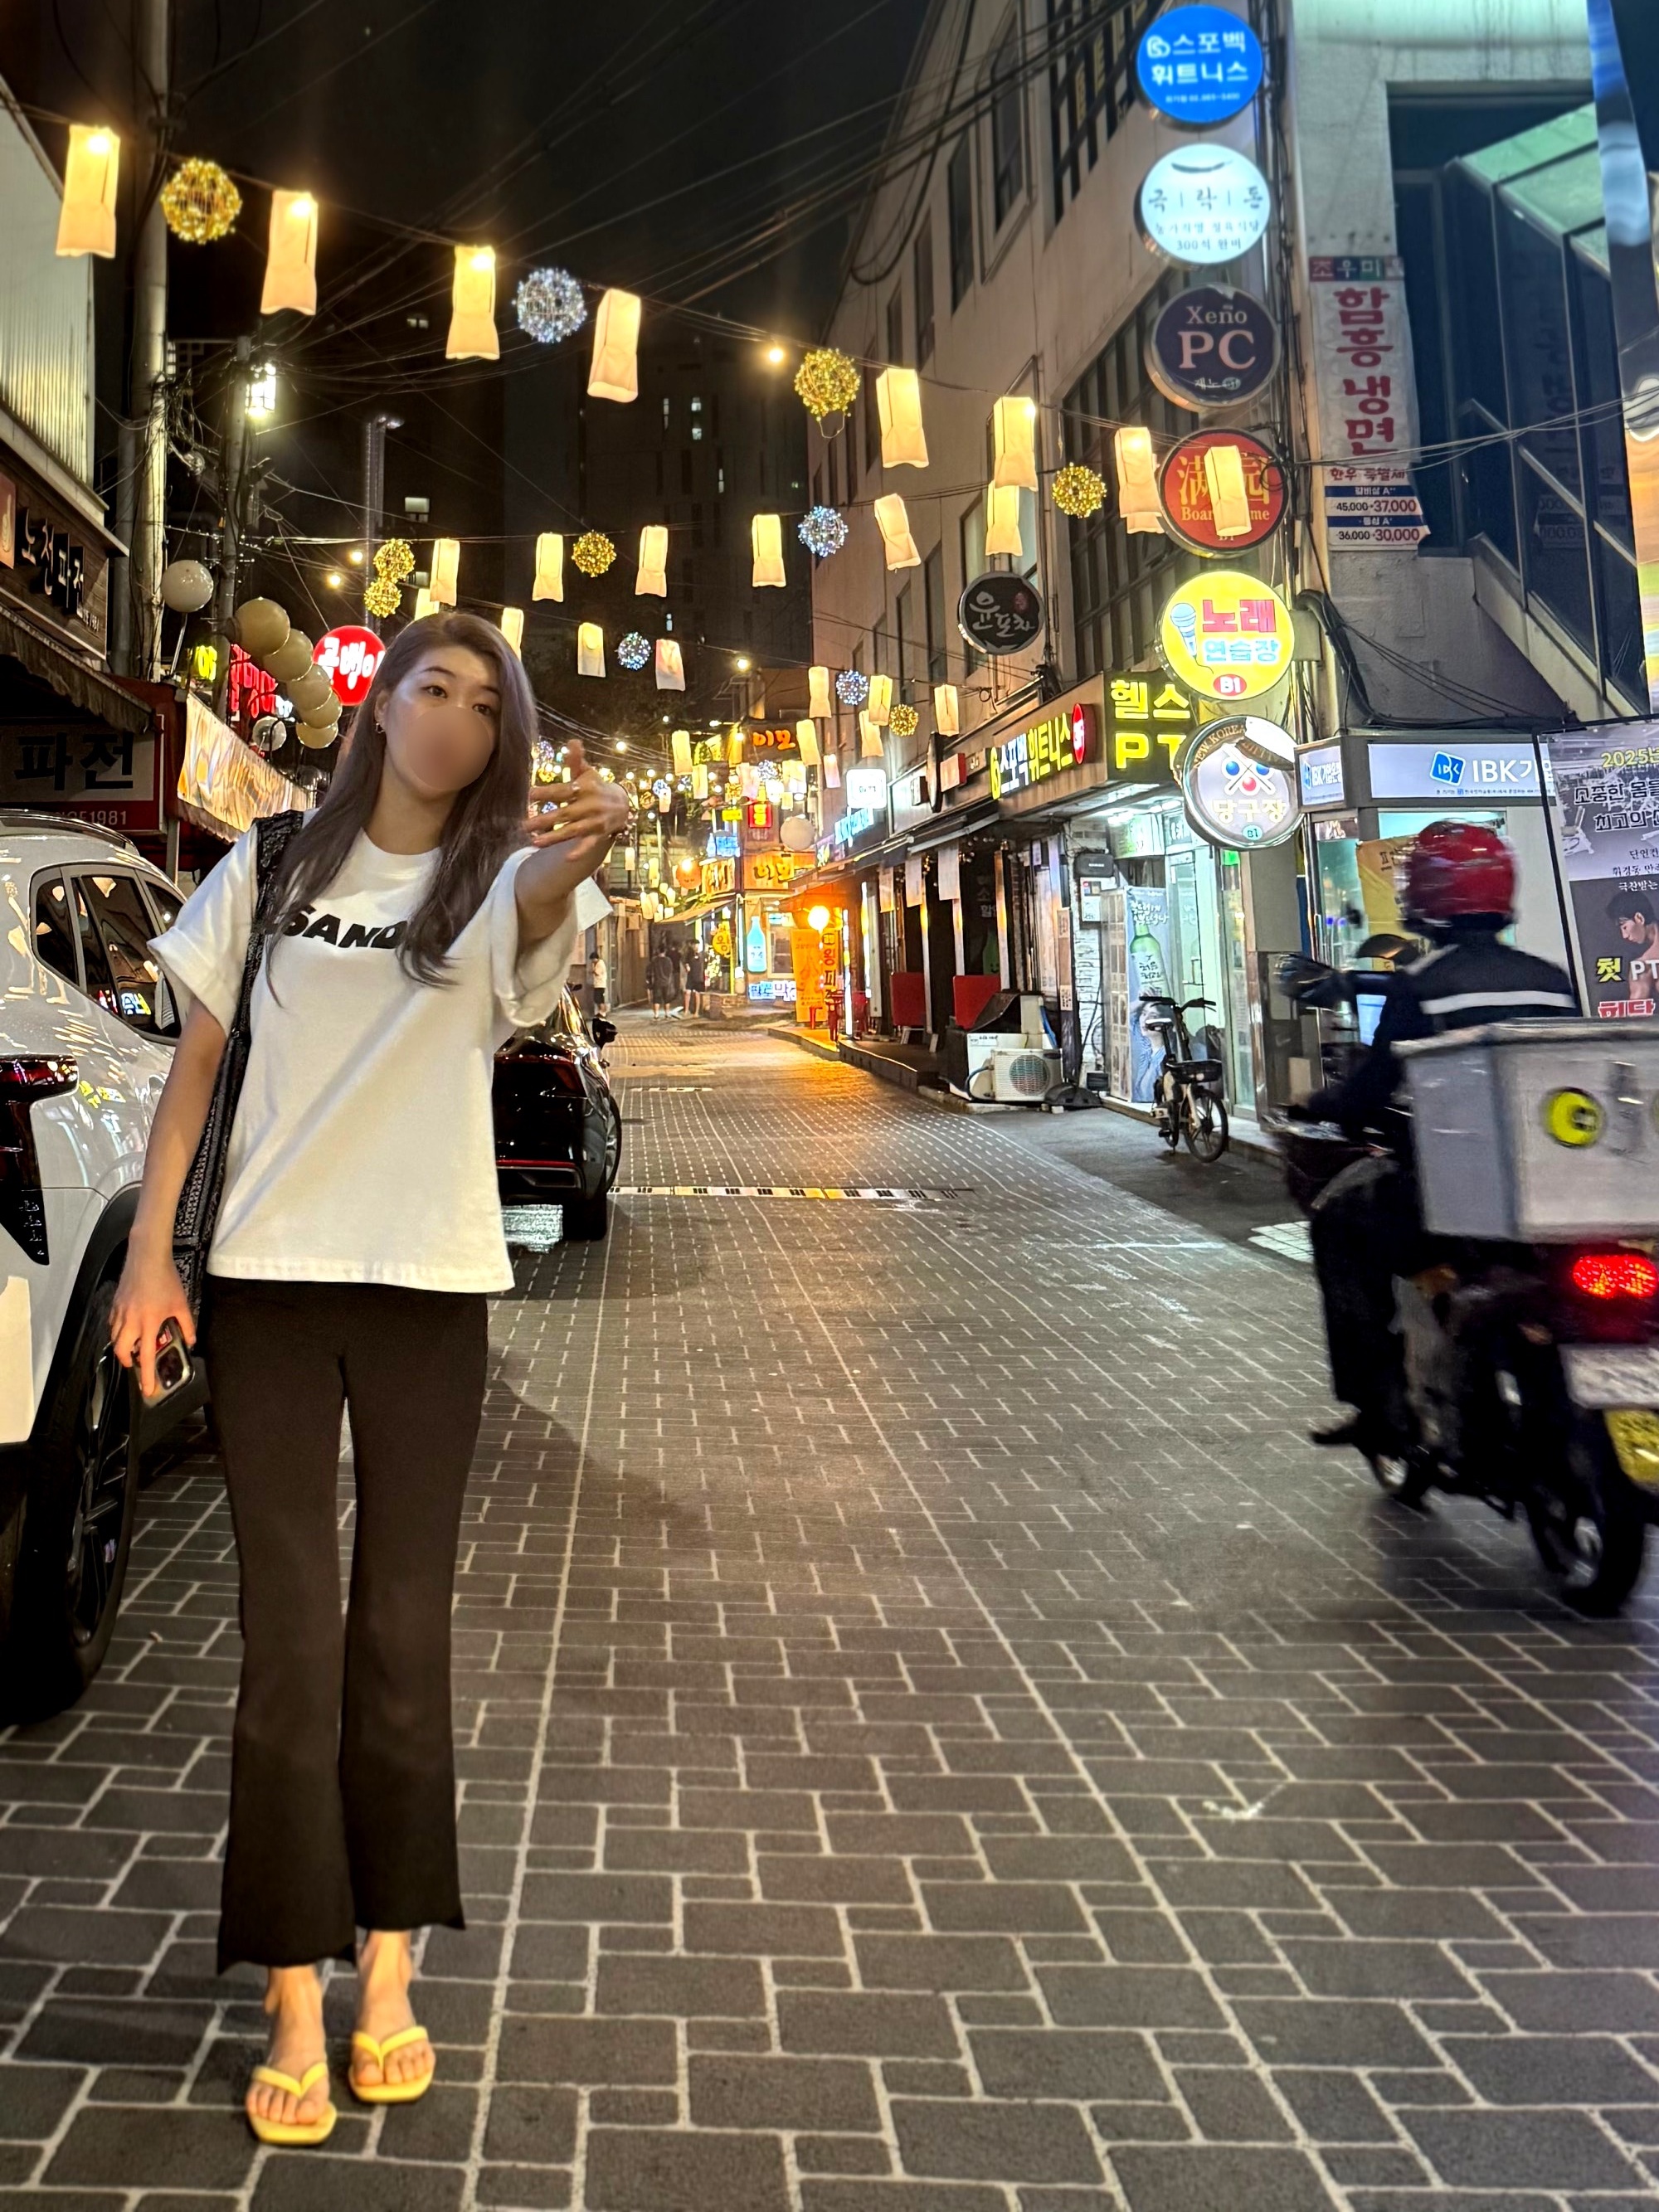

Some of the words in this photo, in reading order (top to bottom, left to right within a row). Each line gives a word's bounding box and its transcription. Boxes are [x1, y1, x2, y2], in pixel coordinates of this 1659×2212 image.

[1178, 329, 1256, 369] PC
[1332, 286, 1399, 456] 함흥냉면
[1330, 467, 1356, 481] 한우
[1181, 507, 1214, 521] Boar
[1336, 502, 1369, 512] 45,000
[1373, 499, 1417, 513] 37,000
[1338, 531, 1370, 541] 36,000
[1374, 528, 1420, 542] 30,000
[1202, 599, 1277, 633] 노래
[1204, 639, 1279, 662] 연습장
[1219, 676, 1242, 693] B1
[1111, 679, 1191, 720] 헬스
[13, 731, 134, 791] 파전
[1115, 732, 1188, 771] PT
[1574, 782, 1624, 805] 소중한
[1213, 799, 1287, 824] 당구장
[1593, 810, 1647, 831] 최고의
[1596, 956, 1624, 984] 첫
[1629, 959, 1659, 981] PT
